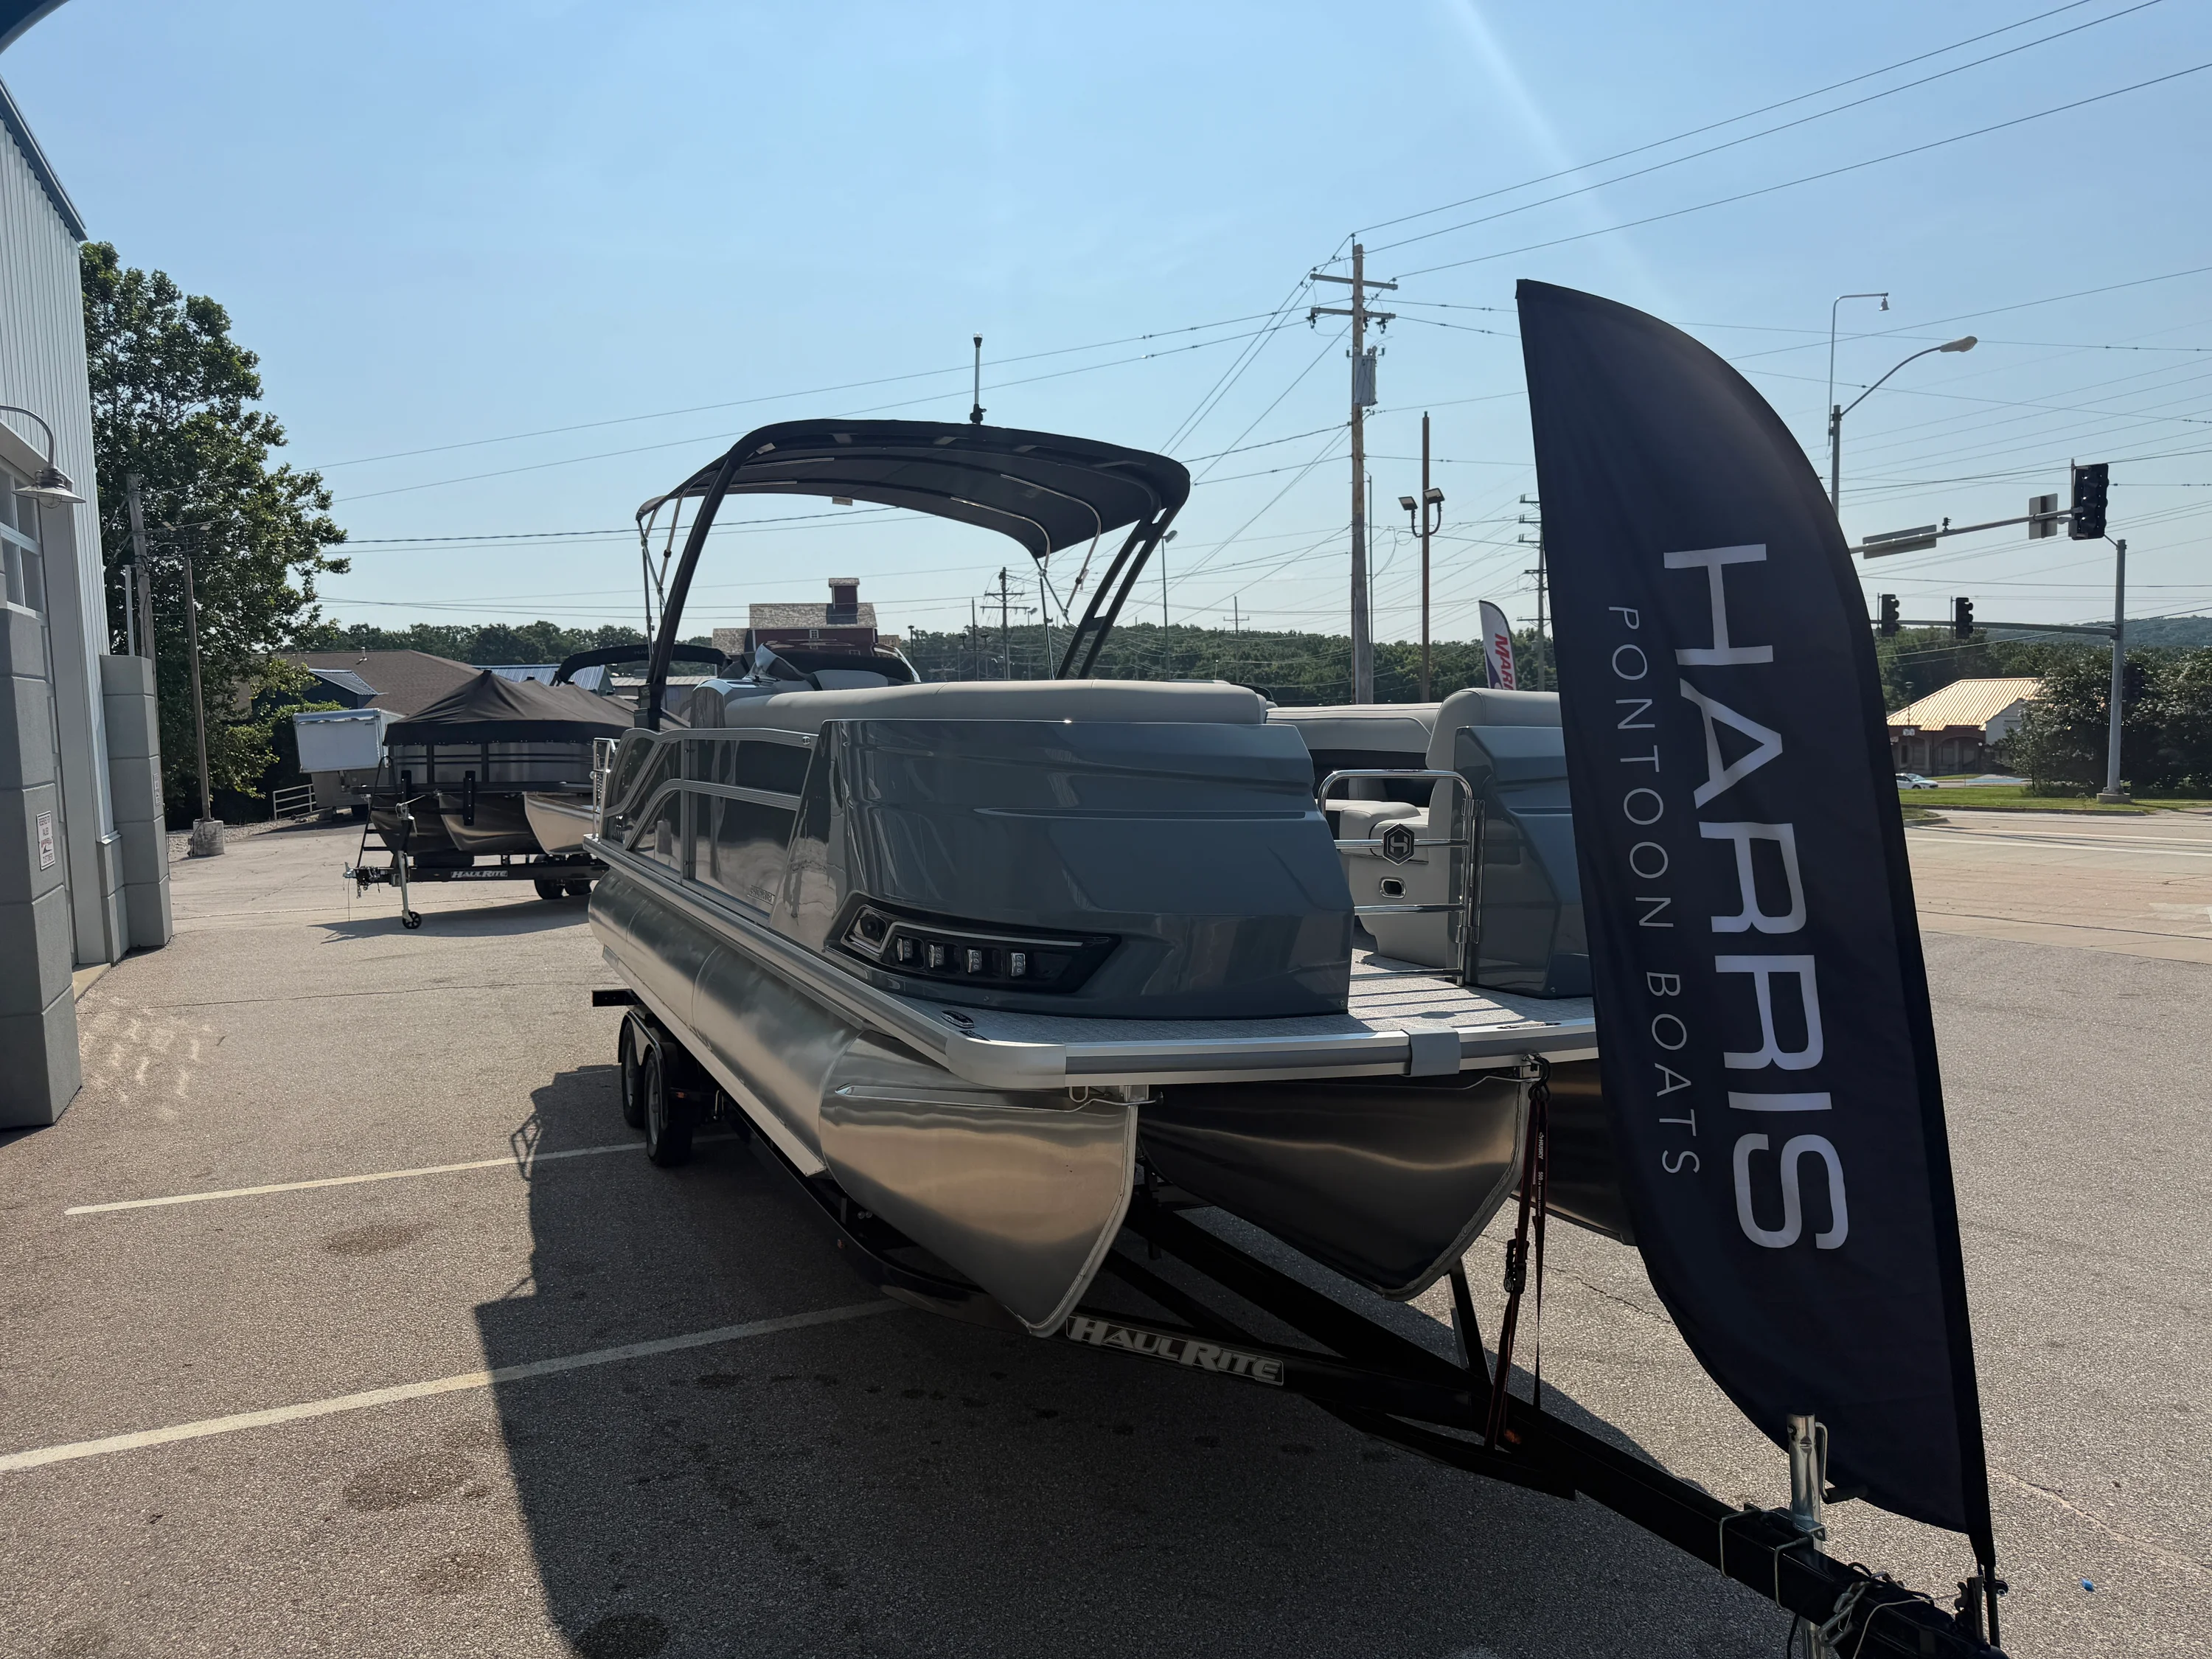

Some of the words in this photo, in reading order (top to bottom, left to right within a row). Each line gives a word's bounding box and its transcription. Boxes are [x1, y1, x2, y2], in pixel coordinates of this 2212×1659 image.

[1609, 606, 1674, 928] PONTOON
[1646, 971, 1700, 1175] BOATS
[1663, 543, 1849, 1251] HARRIS
[1070, 1316, 1281, 1381] HAULRITE
